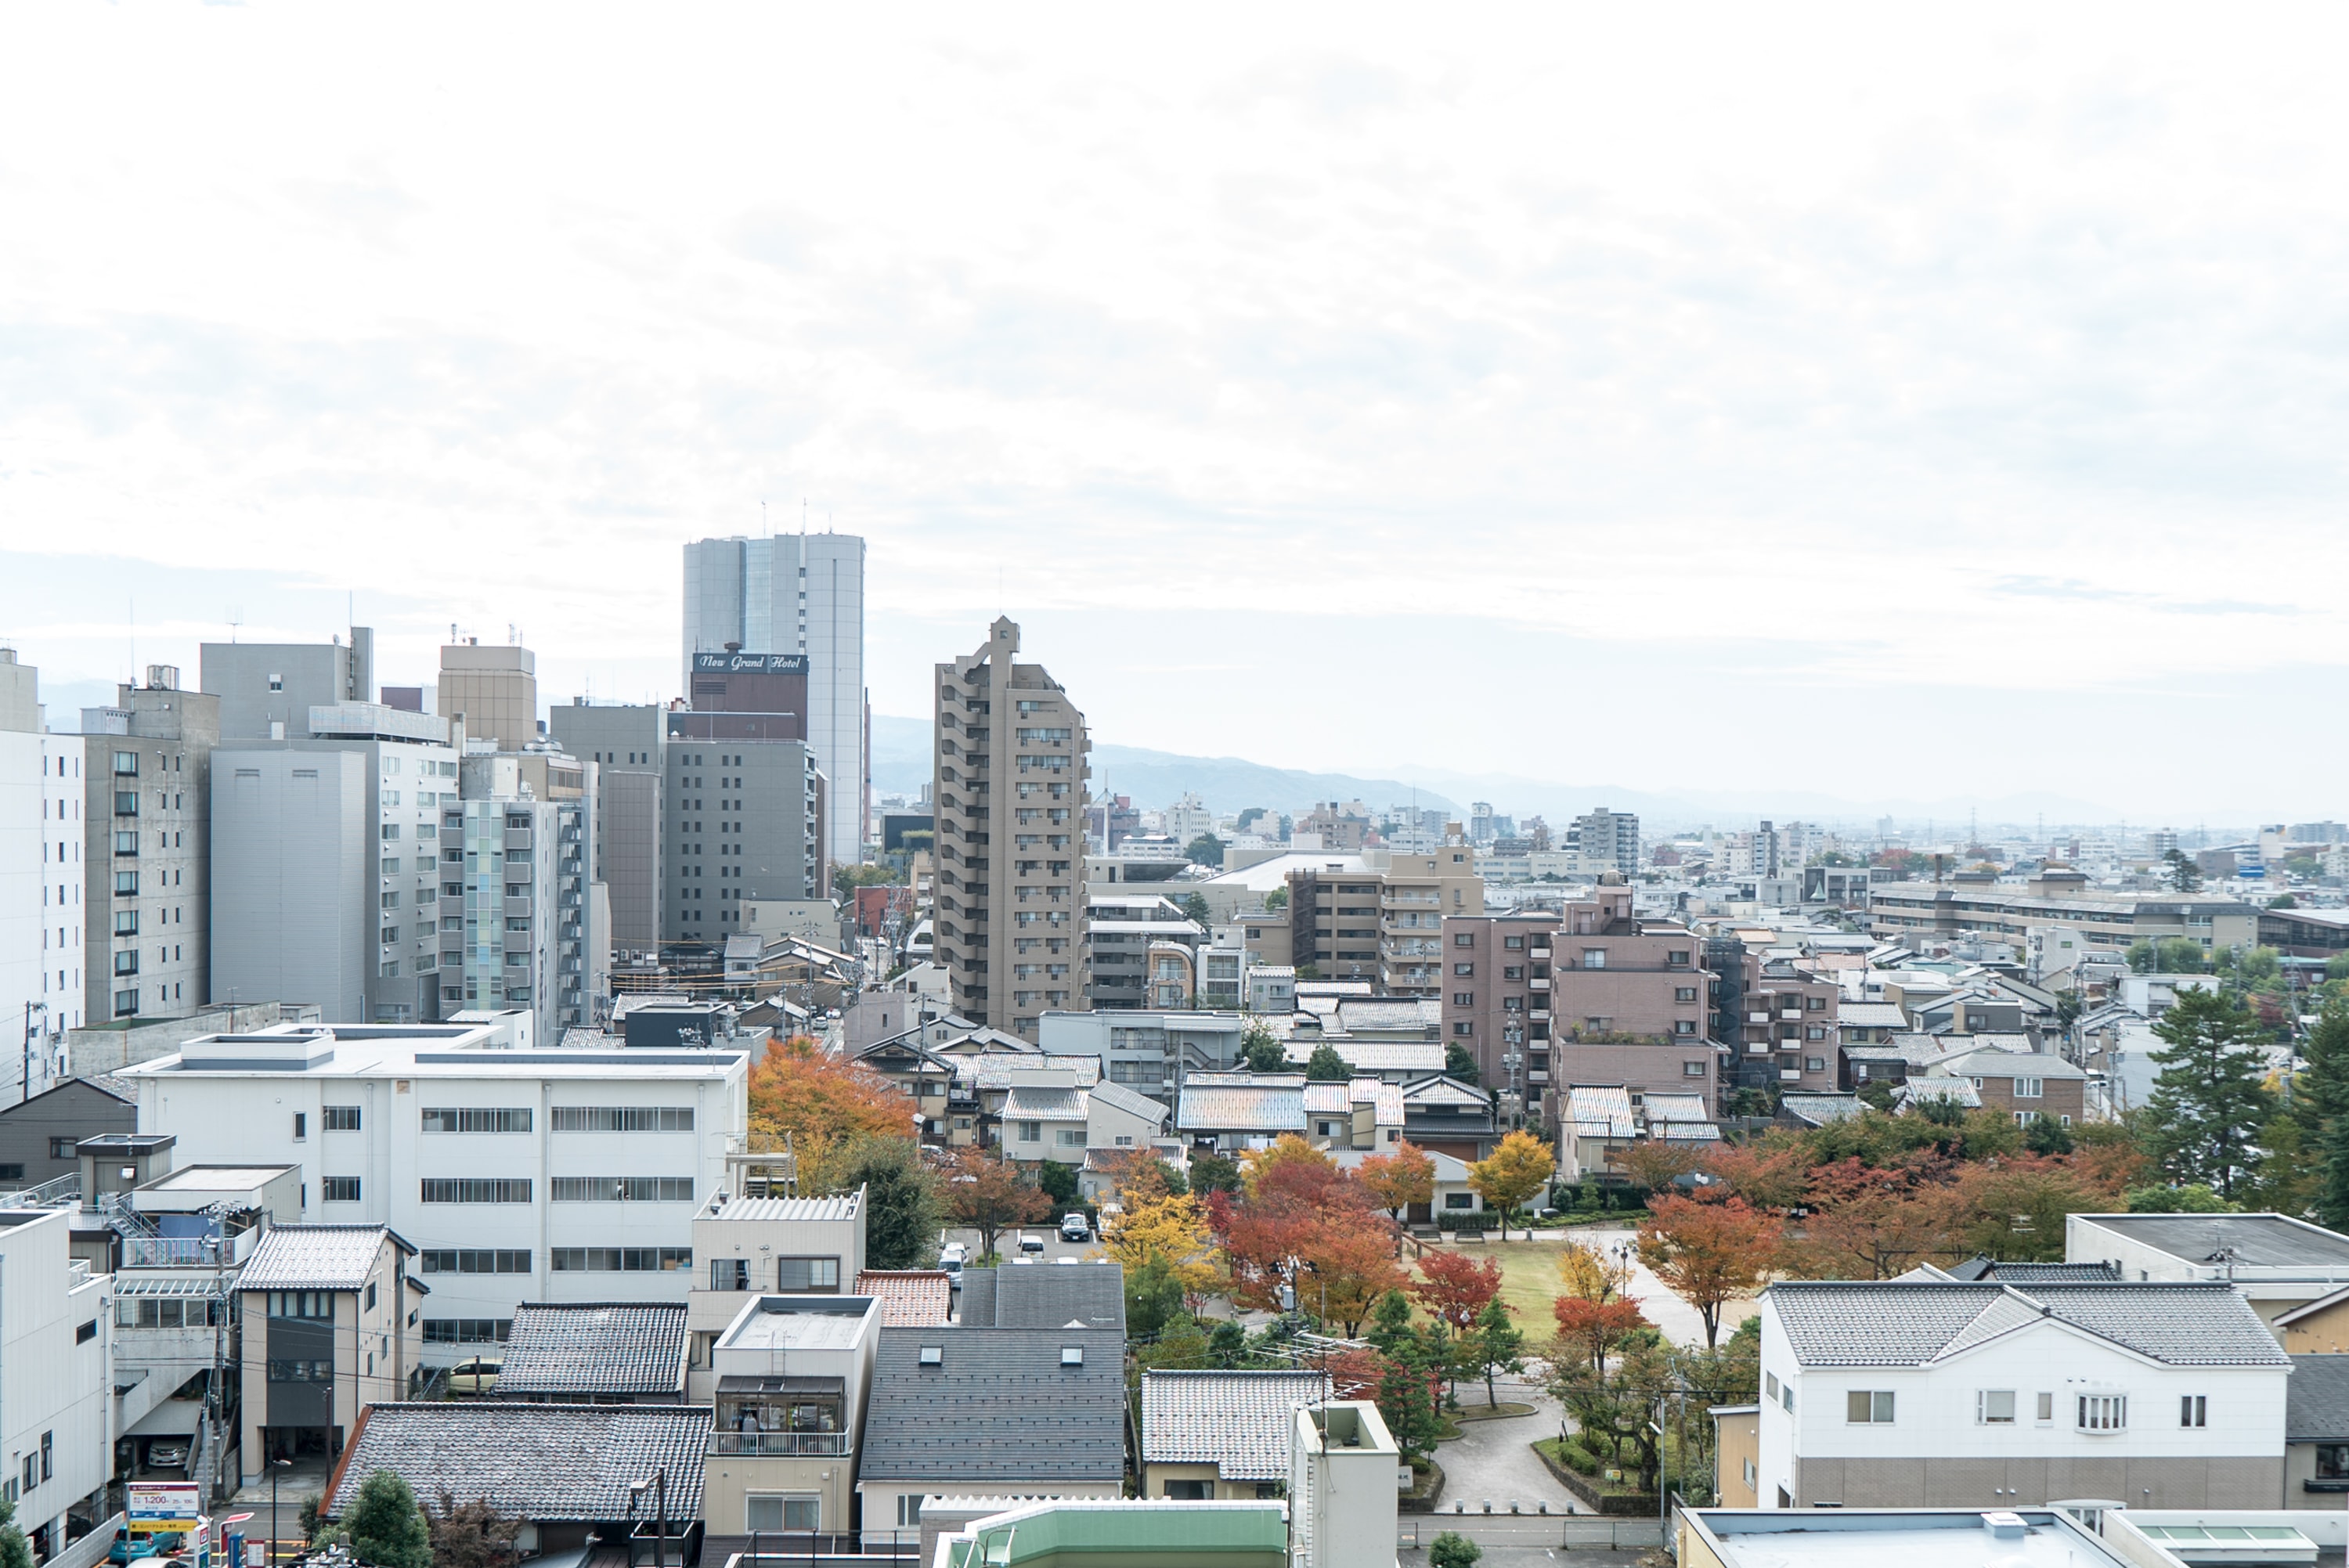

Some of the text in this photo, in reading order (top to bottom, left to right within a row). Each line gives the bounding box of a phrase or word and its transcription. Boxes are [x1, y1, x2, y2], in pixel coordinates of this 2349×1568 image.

[699, 655, 801, 671] New Grand Hotel
